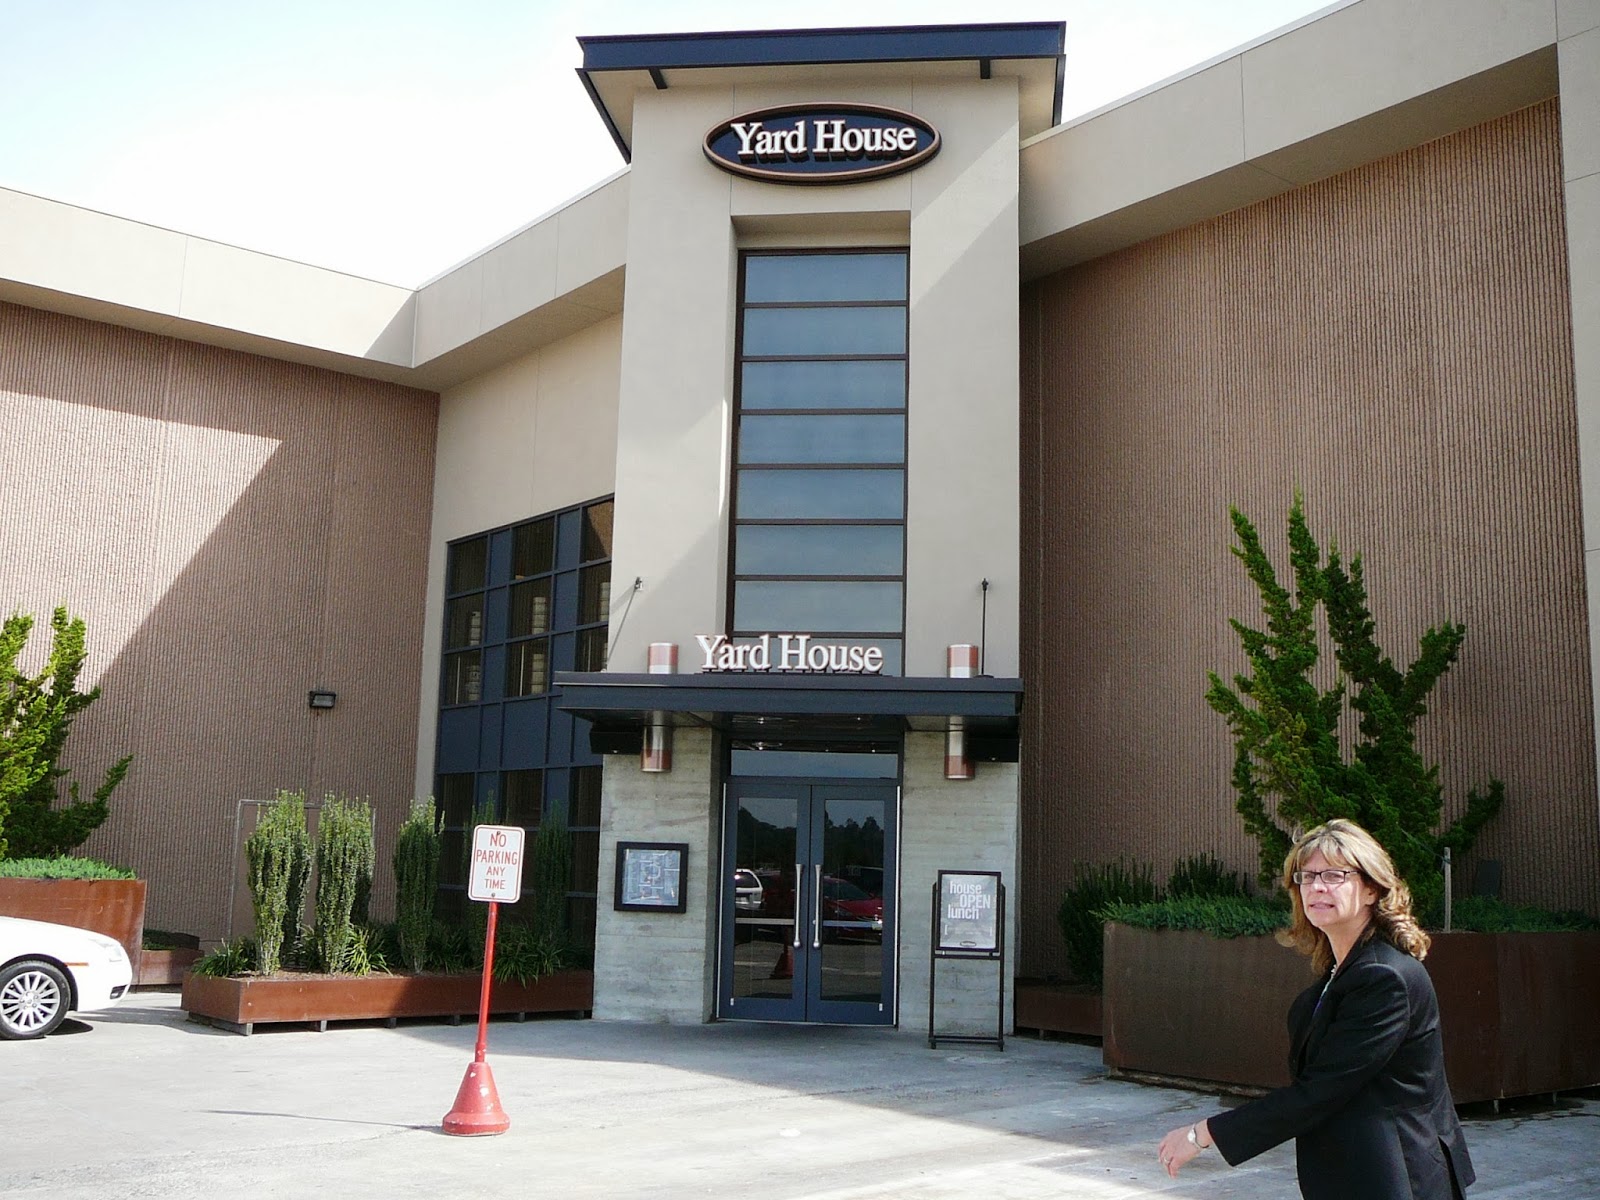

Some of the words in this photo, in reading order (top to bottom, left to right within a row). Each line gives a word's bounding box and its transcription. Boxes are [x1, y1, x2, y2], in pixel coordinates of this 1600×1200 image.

[731, 120, 807, 155] Yard
[813, 119, 918, 152] House
[695, 634, 771, 670] Yard
[777, 634, 884, 672] House
[489, 833, 507, 847] NO
[475, 849, 518, 865] PARKING
[486, 866, 506, 876] ANY
[484, 878, 506, 890] TIME
[949, 880, 982, 895] house
[959, 894, 991, 909] OPEN
[947, 904, 980, 919] lunch
